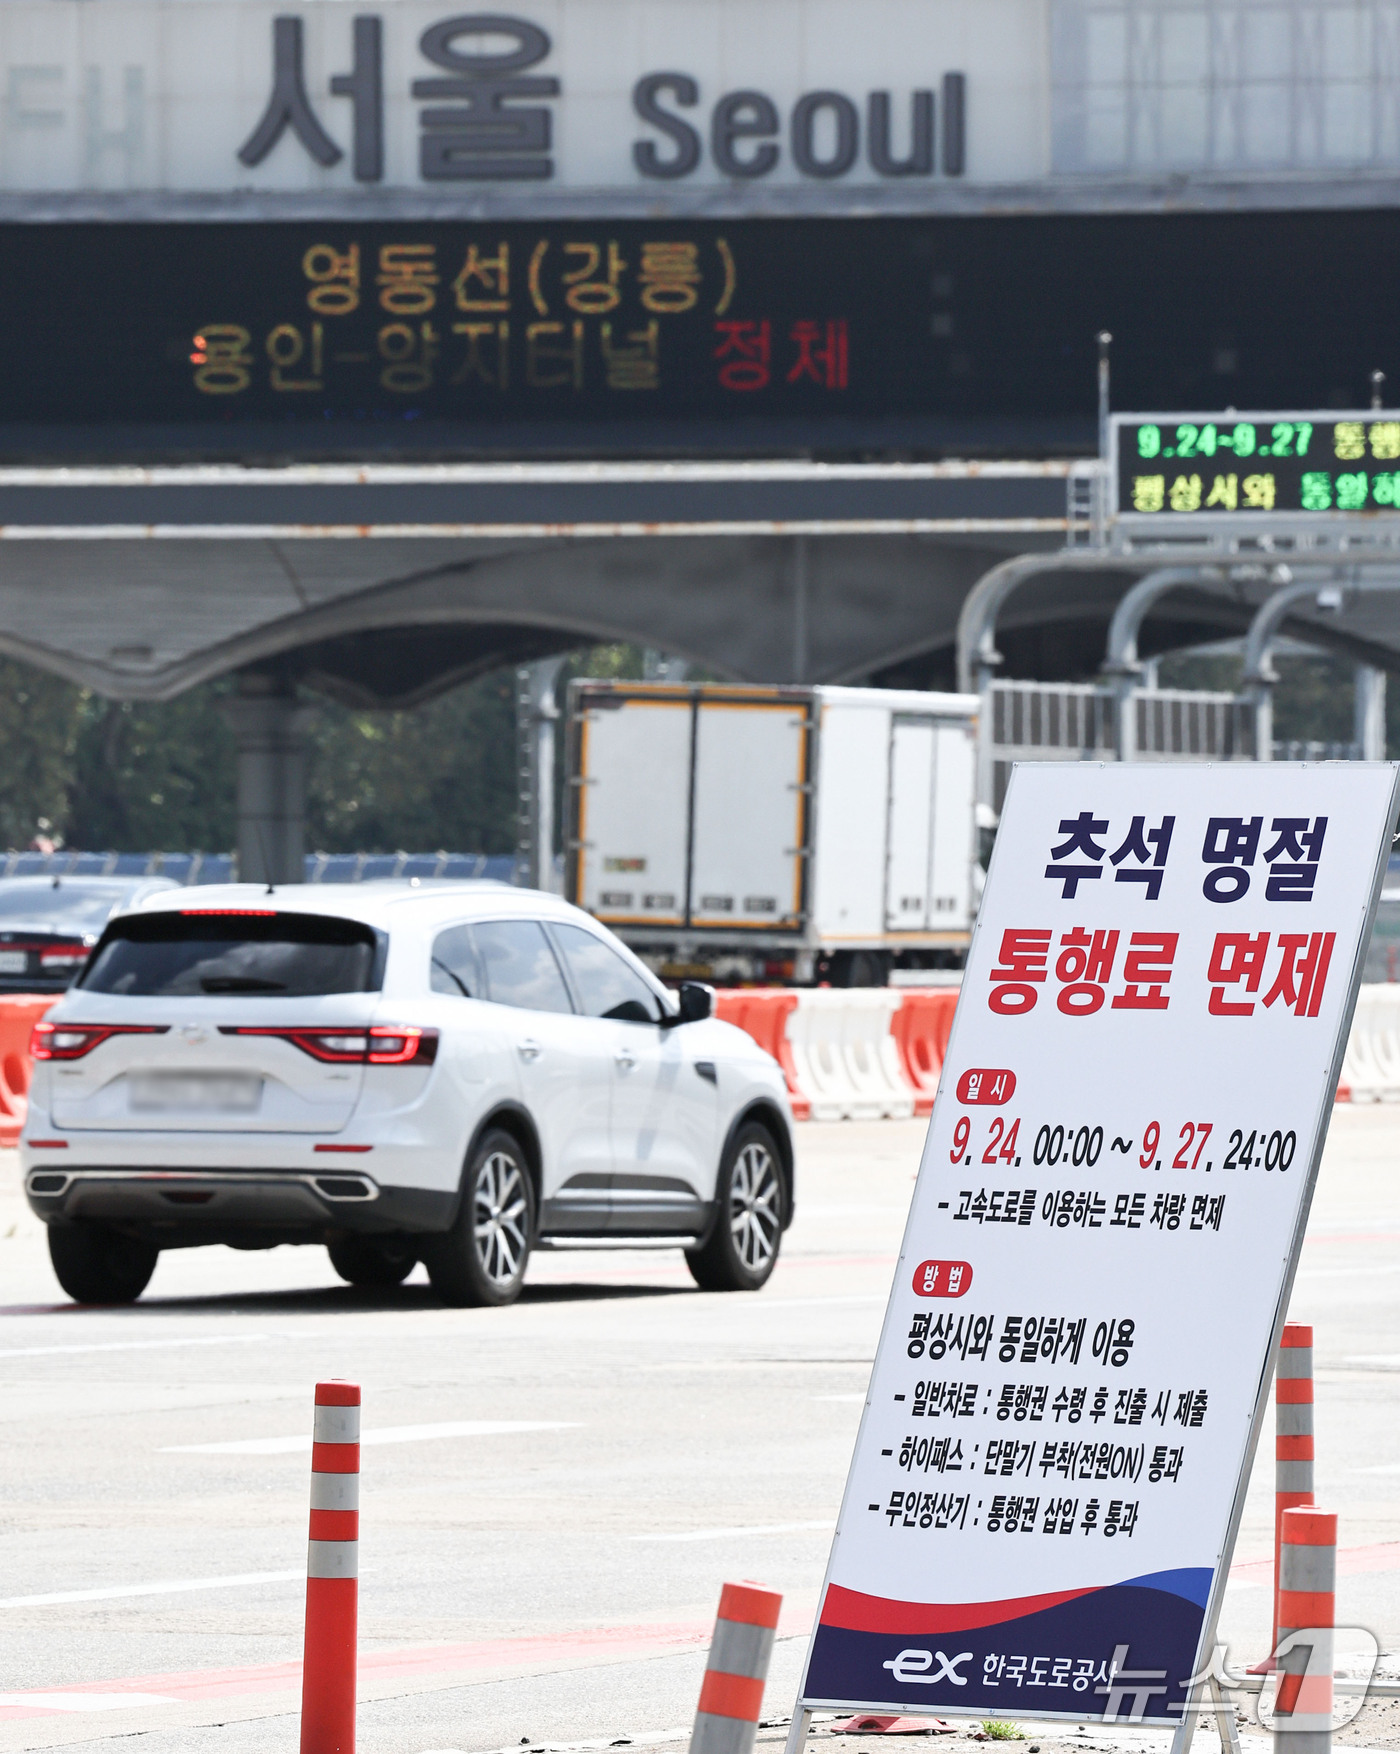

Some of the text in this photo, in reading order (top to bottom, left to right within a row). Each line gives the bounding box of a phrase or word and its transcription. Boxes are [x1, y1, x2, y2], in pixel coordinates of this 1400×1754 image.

[237, 15, 560, 183] 서울
[632, 71, 965, 180] Seoul
[303, 238, 736, 316] 영동선(강릉)
[712, 319, 850, 391] 정체
[1132, 473, 1275, 512] 평상시와
[1044, 811, 1329, 903] 추석 명절
[987, 926, 1337, 1018] 통행료 면제
[1032, 1124, 1104, 1168] 00:00
[1222, 1128, 1297, 1172] 24:00
[952, 1187, 1038, 1226] 고속도로를
[1041, 1190, 1107, 1228] 이용하는
[1109, 1192, 1147, 1229] 모든
[1149, 1192, 1187, 1231] 차량
[1189, 1193, 1226, 1232] 면제
[907, 1312, 1136, 1368] 평상시와 동일하게 이용
[911, 1380, 979, 1419] 일반차로
[996, 1383, 1050, 1422] 통행권
[1051, 1385, 1088, 1424] 수령
[1088, 1386, 1109, 1424] 후
[1113, 1387, 1148, 1426] 진출
[1150, 1389, 1172, 1427] 시
[1173, 1389, 1209, 1428] 제출
[898, 1435, 964, 1474] 하이패스
[983, 1439, 1037, 1478] 단말기
[1038, 1440, 1145, 1484] 부착(전원ON)
[1148, 1445, 1185, 1483] 통과
[885, 1490, 971, 1531] 무인정산기
[986, 1495, 1041, 1534] 통행권
[1042, 1497, 1080, 1535] 삽입
[1080, 1498, 1101, 1536] 후
[1103, 1500, 1140, 1538] 통과
[981, 1652, 1119, 1694] 한국도로공사
